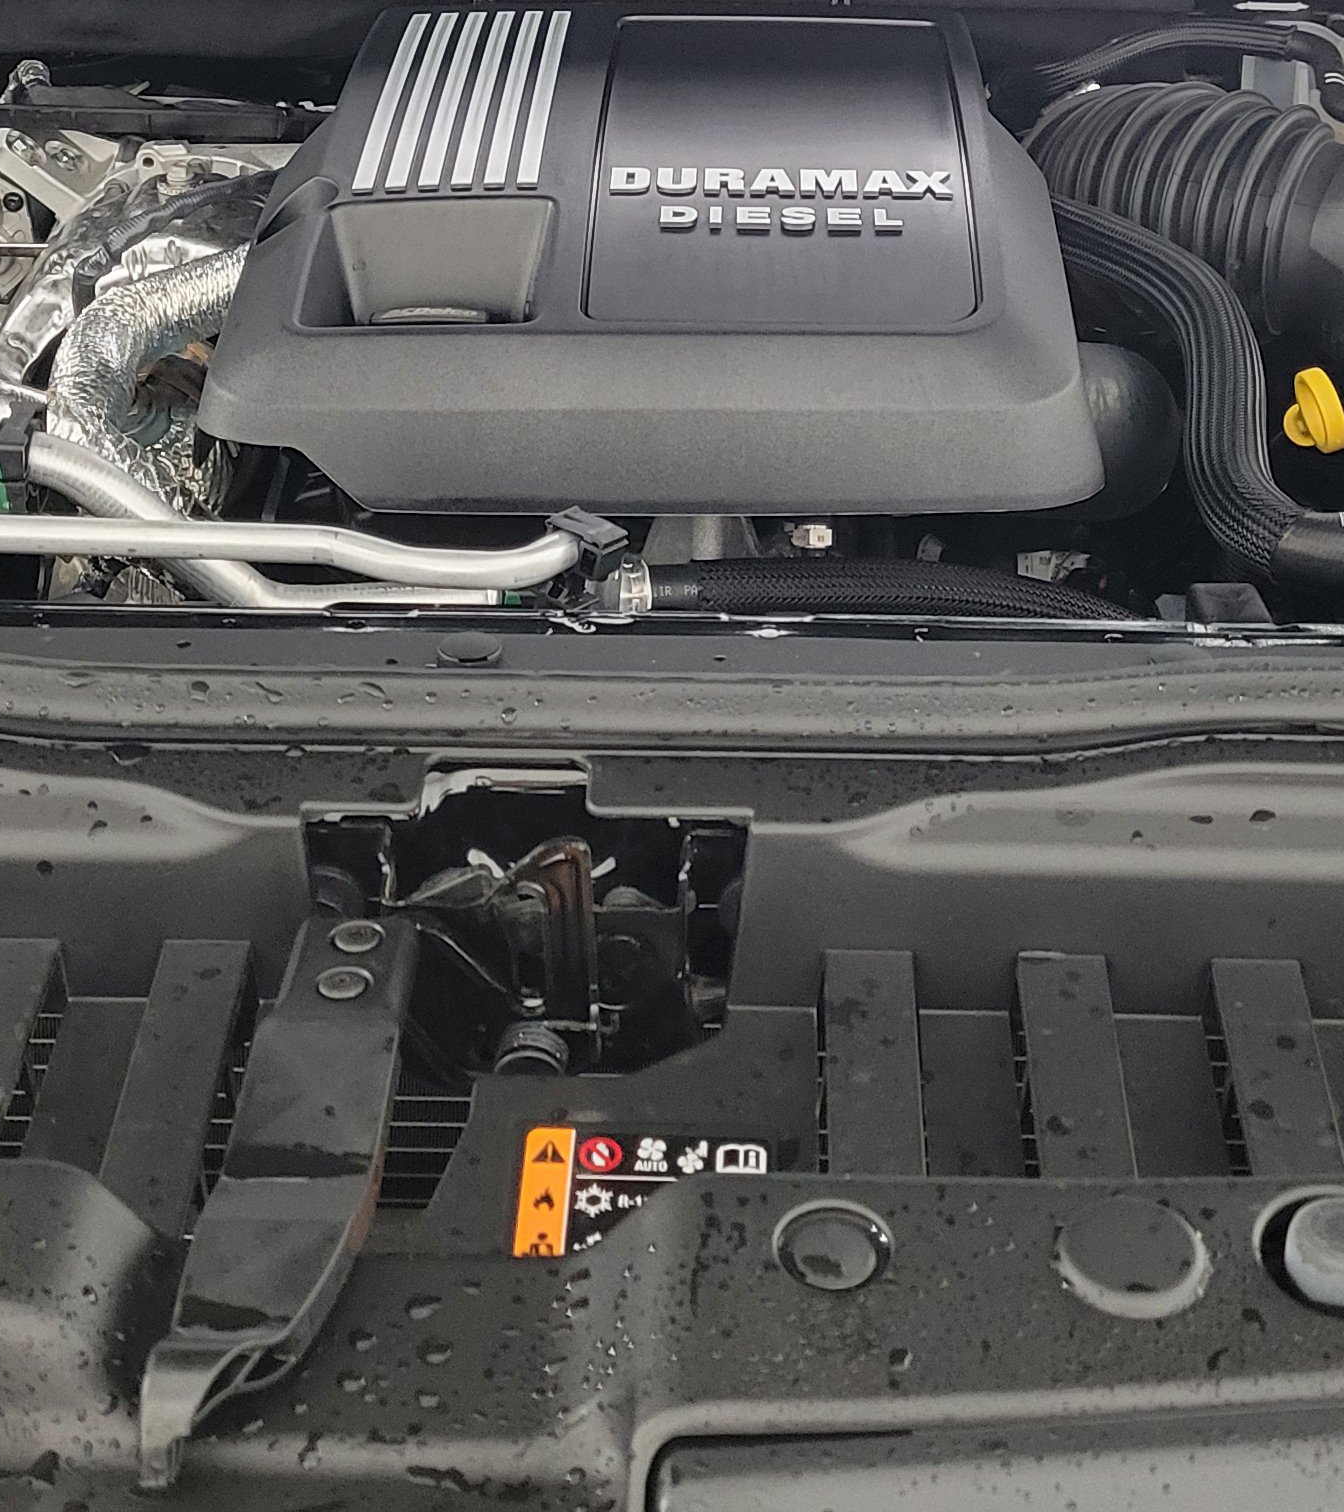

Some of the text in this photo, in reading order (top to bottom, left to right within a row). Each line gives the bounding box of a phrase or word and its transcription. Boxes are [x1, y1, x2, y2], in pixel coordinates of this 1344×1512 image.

[609, 166, 954, 200] DURAMAX
[659, 205, 905, 236] DIESEL
[633, 1159, 669, 1173] AUTO
